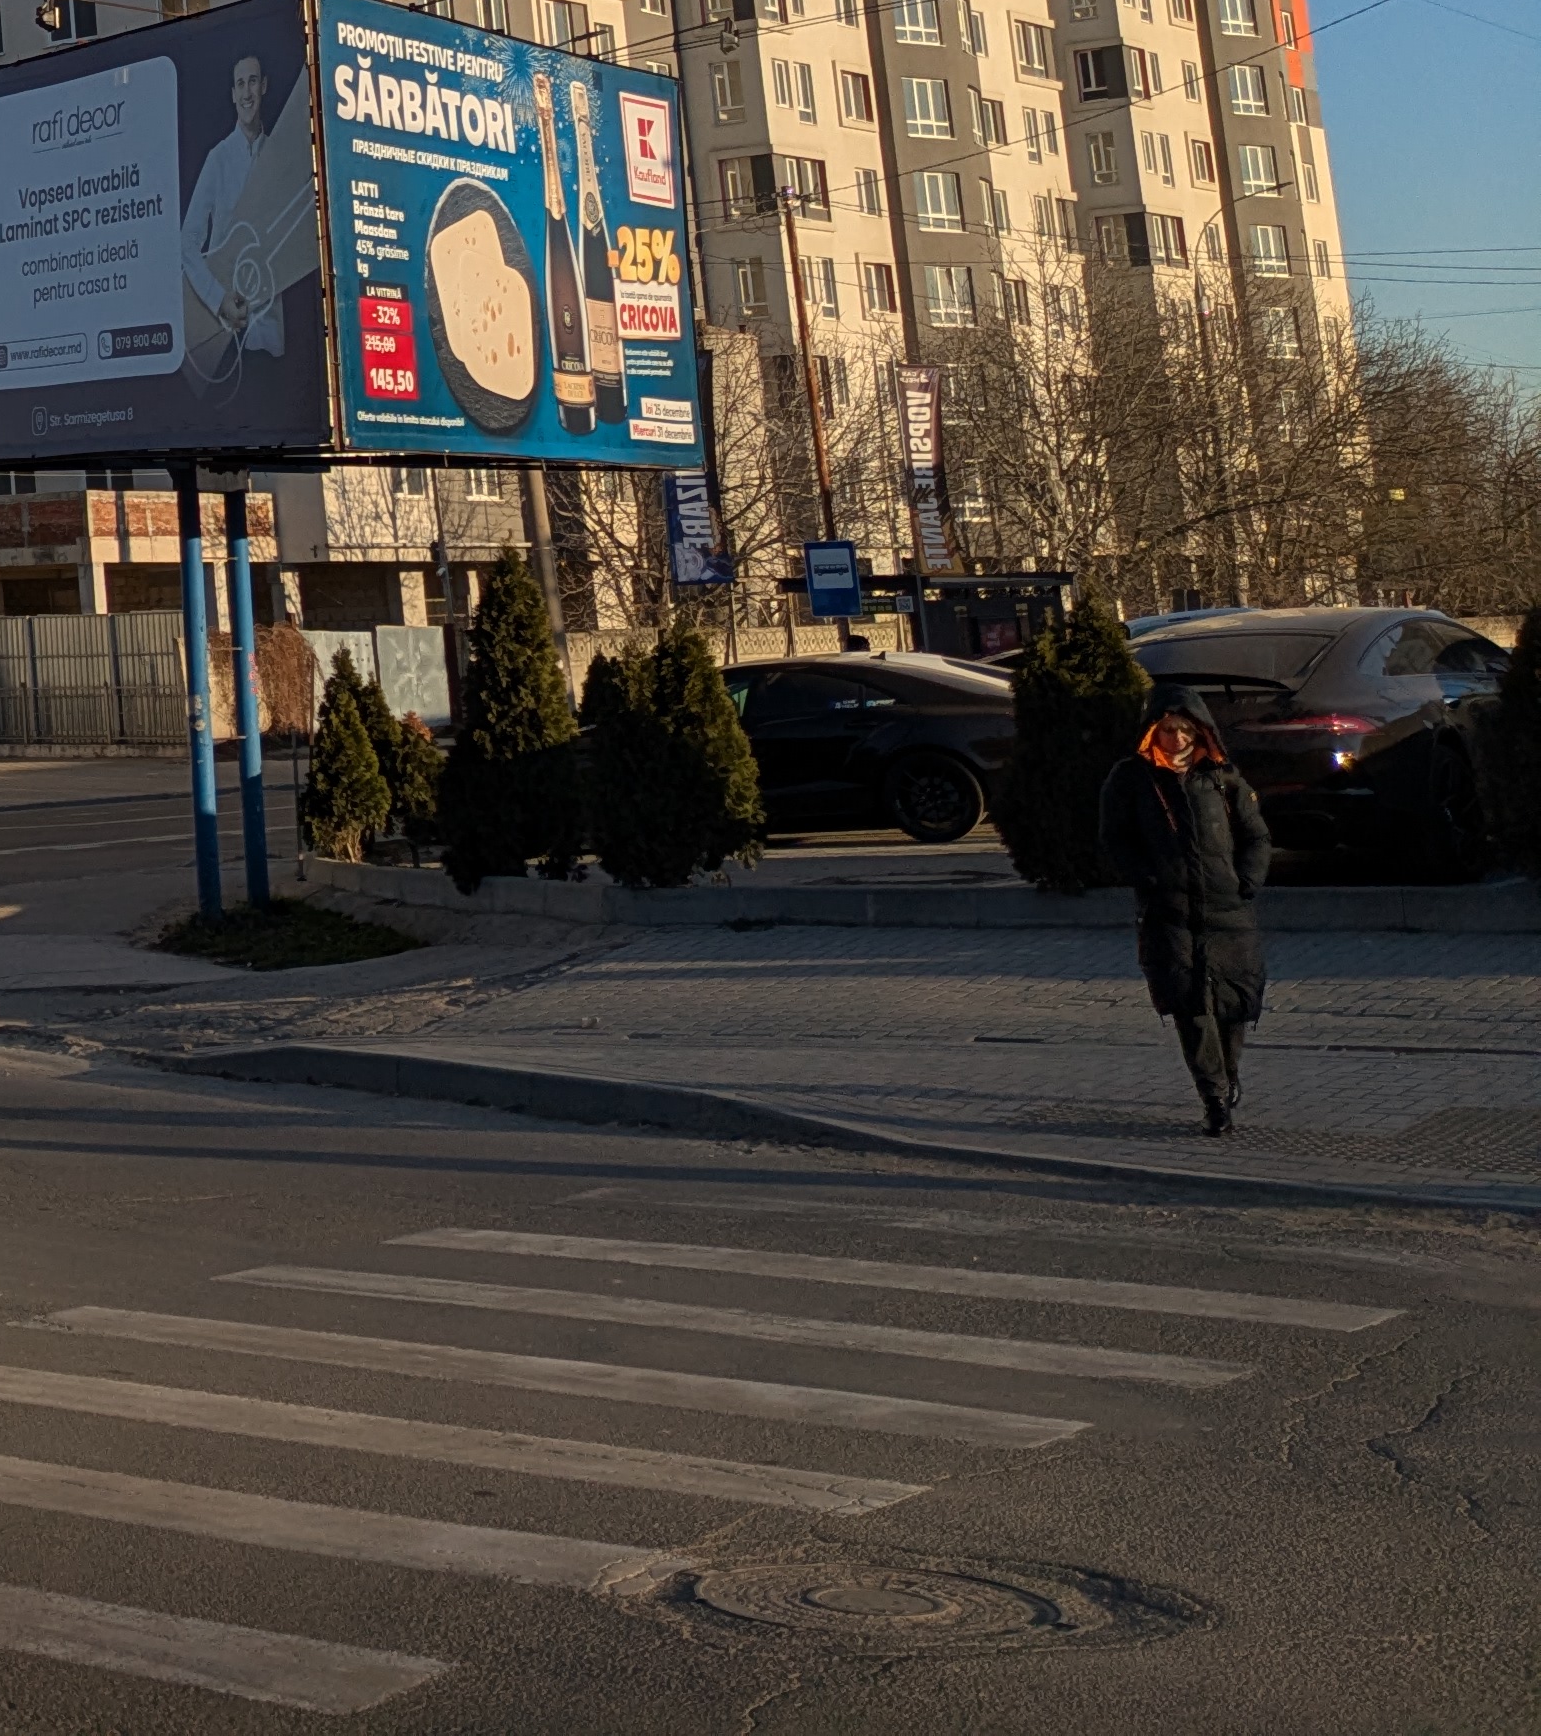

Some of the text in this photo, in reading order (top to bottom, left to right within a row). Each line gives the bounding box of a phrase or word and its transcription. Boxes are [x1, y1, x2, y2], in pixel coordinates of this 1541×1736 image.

[337, 22, 504, 83] PROMOȚII FESTIVE PENTRU
[334, 53, 516, 155] SĂRBĂTORI
[32, 100, 126, 144] rafi decor
[352, 138, 416, 164] ПРАЗДНИЧНЫЕ
[416, 151, 449, 171] СКИДКИ
[456, 158, 509, 182] ПРАЗДНИКАМ
[633, 165, 667, 187] Kaufland
[19, 163, 140, 213] Vopsea lavabilă
[351, 180, 379, 199] LATTI
[0, 193, 163, 244] Laminat SPC rezistent
[354, 219, 397, 240] Maasdam
[385, 206, 405, 222] tare
[21, 238, 139, 277] combinația ideală
[356, 238, 375, 256] 45%
[607, 225, 681, 286] -25%
[356, 258, 369, 278] kg
[33, 272, 127, 309] pentru casa ta
[366, 285, 375, 297] LA
[371, 305, 401, 326] -32%
[619, 302, 678, 334] CRICOVA
[370, 367, 415, 395] 145,50
